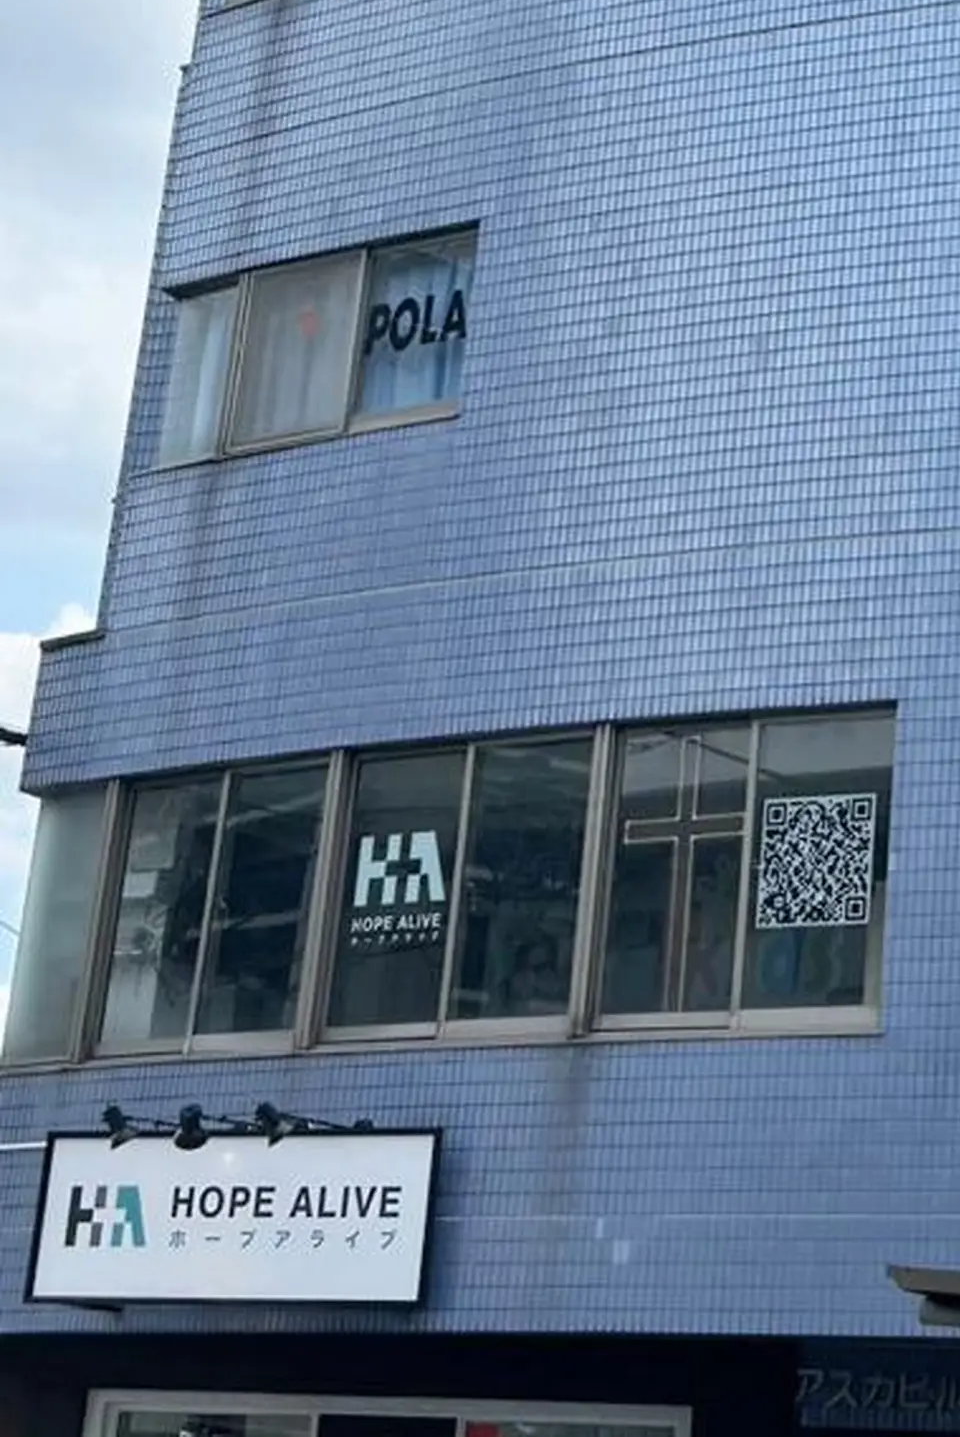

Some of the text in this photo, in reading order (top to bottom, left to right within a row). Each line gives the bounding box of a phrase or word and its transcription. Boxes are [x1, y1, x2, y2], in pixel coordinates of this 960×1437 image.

[363, 290, 466, 355] POLA
[396, 912, 442, 929] ALIVE
[171, 1186, 402, 1218] HOPE ALIVE
